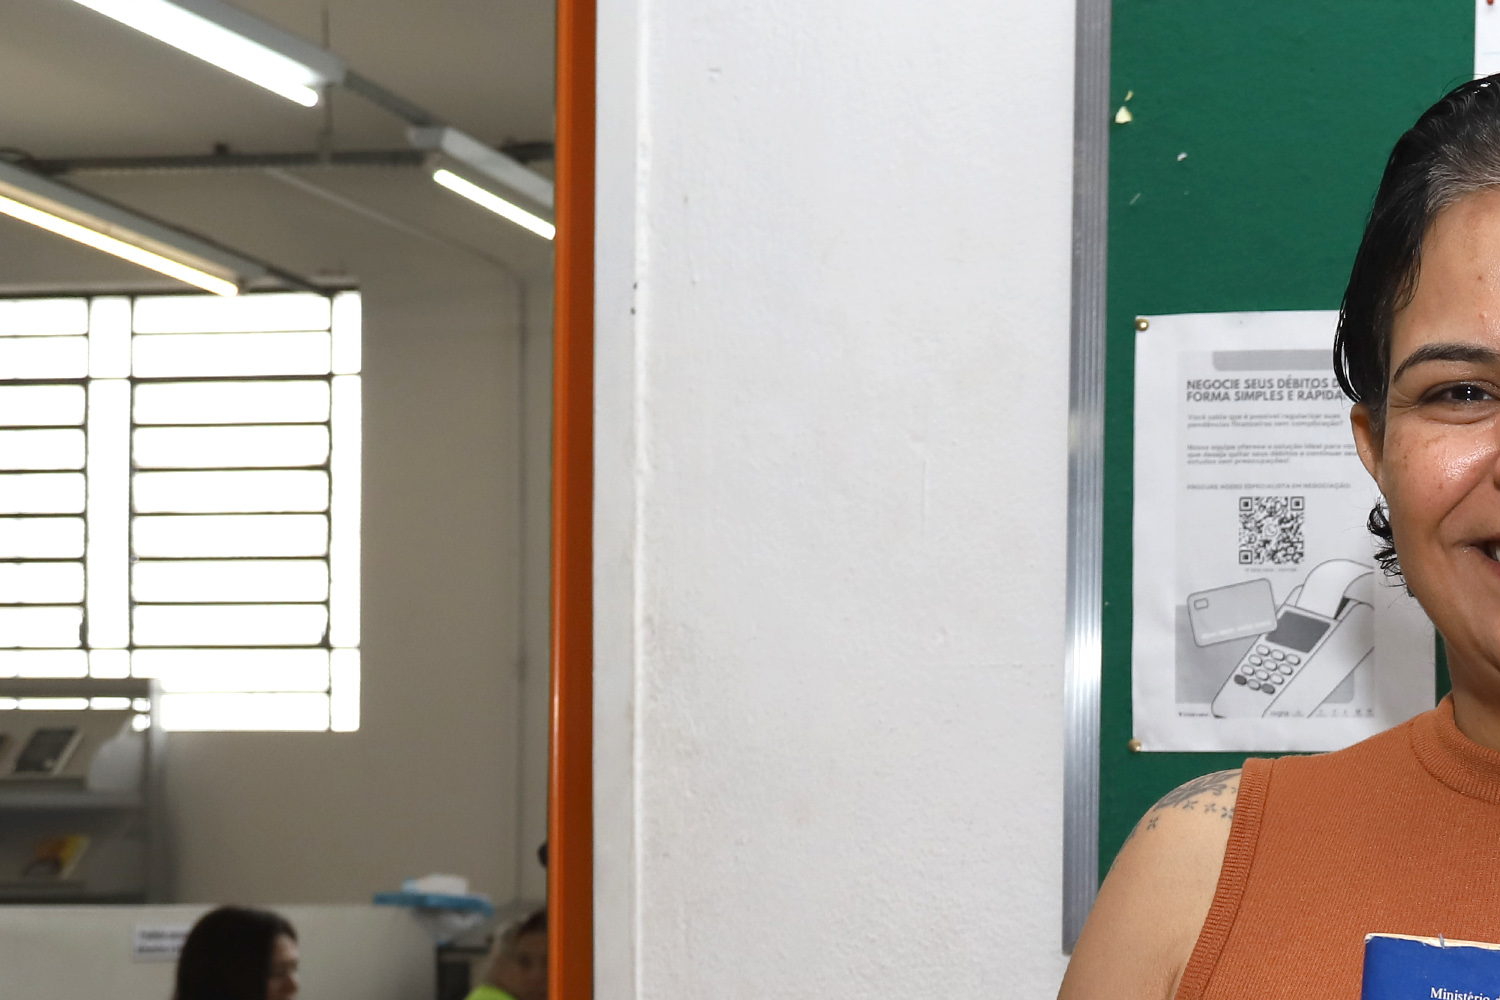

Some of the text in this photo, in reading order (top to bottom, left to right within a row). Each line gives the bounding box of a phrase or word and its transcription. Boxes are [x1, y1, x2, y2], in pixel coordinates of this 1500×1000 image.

[1186, 379, 1240, 390] NEGOCIE
[1243, 378, 1274, 389] SEUS
[1276, 374, 1328, 389] DÉBITOS
[1186, 390, 1231, 402] FORMA
[1234, 390, 1284, 401] SIMPLES
[1287, 390, 1294, 400] E
